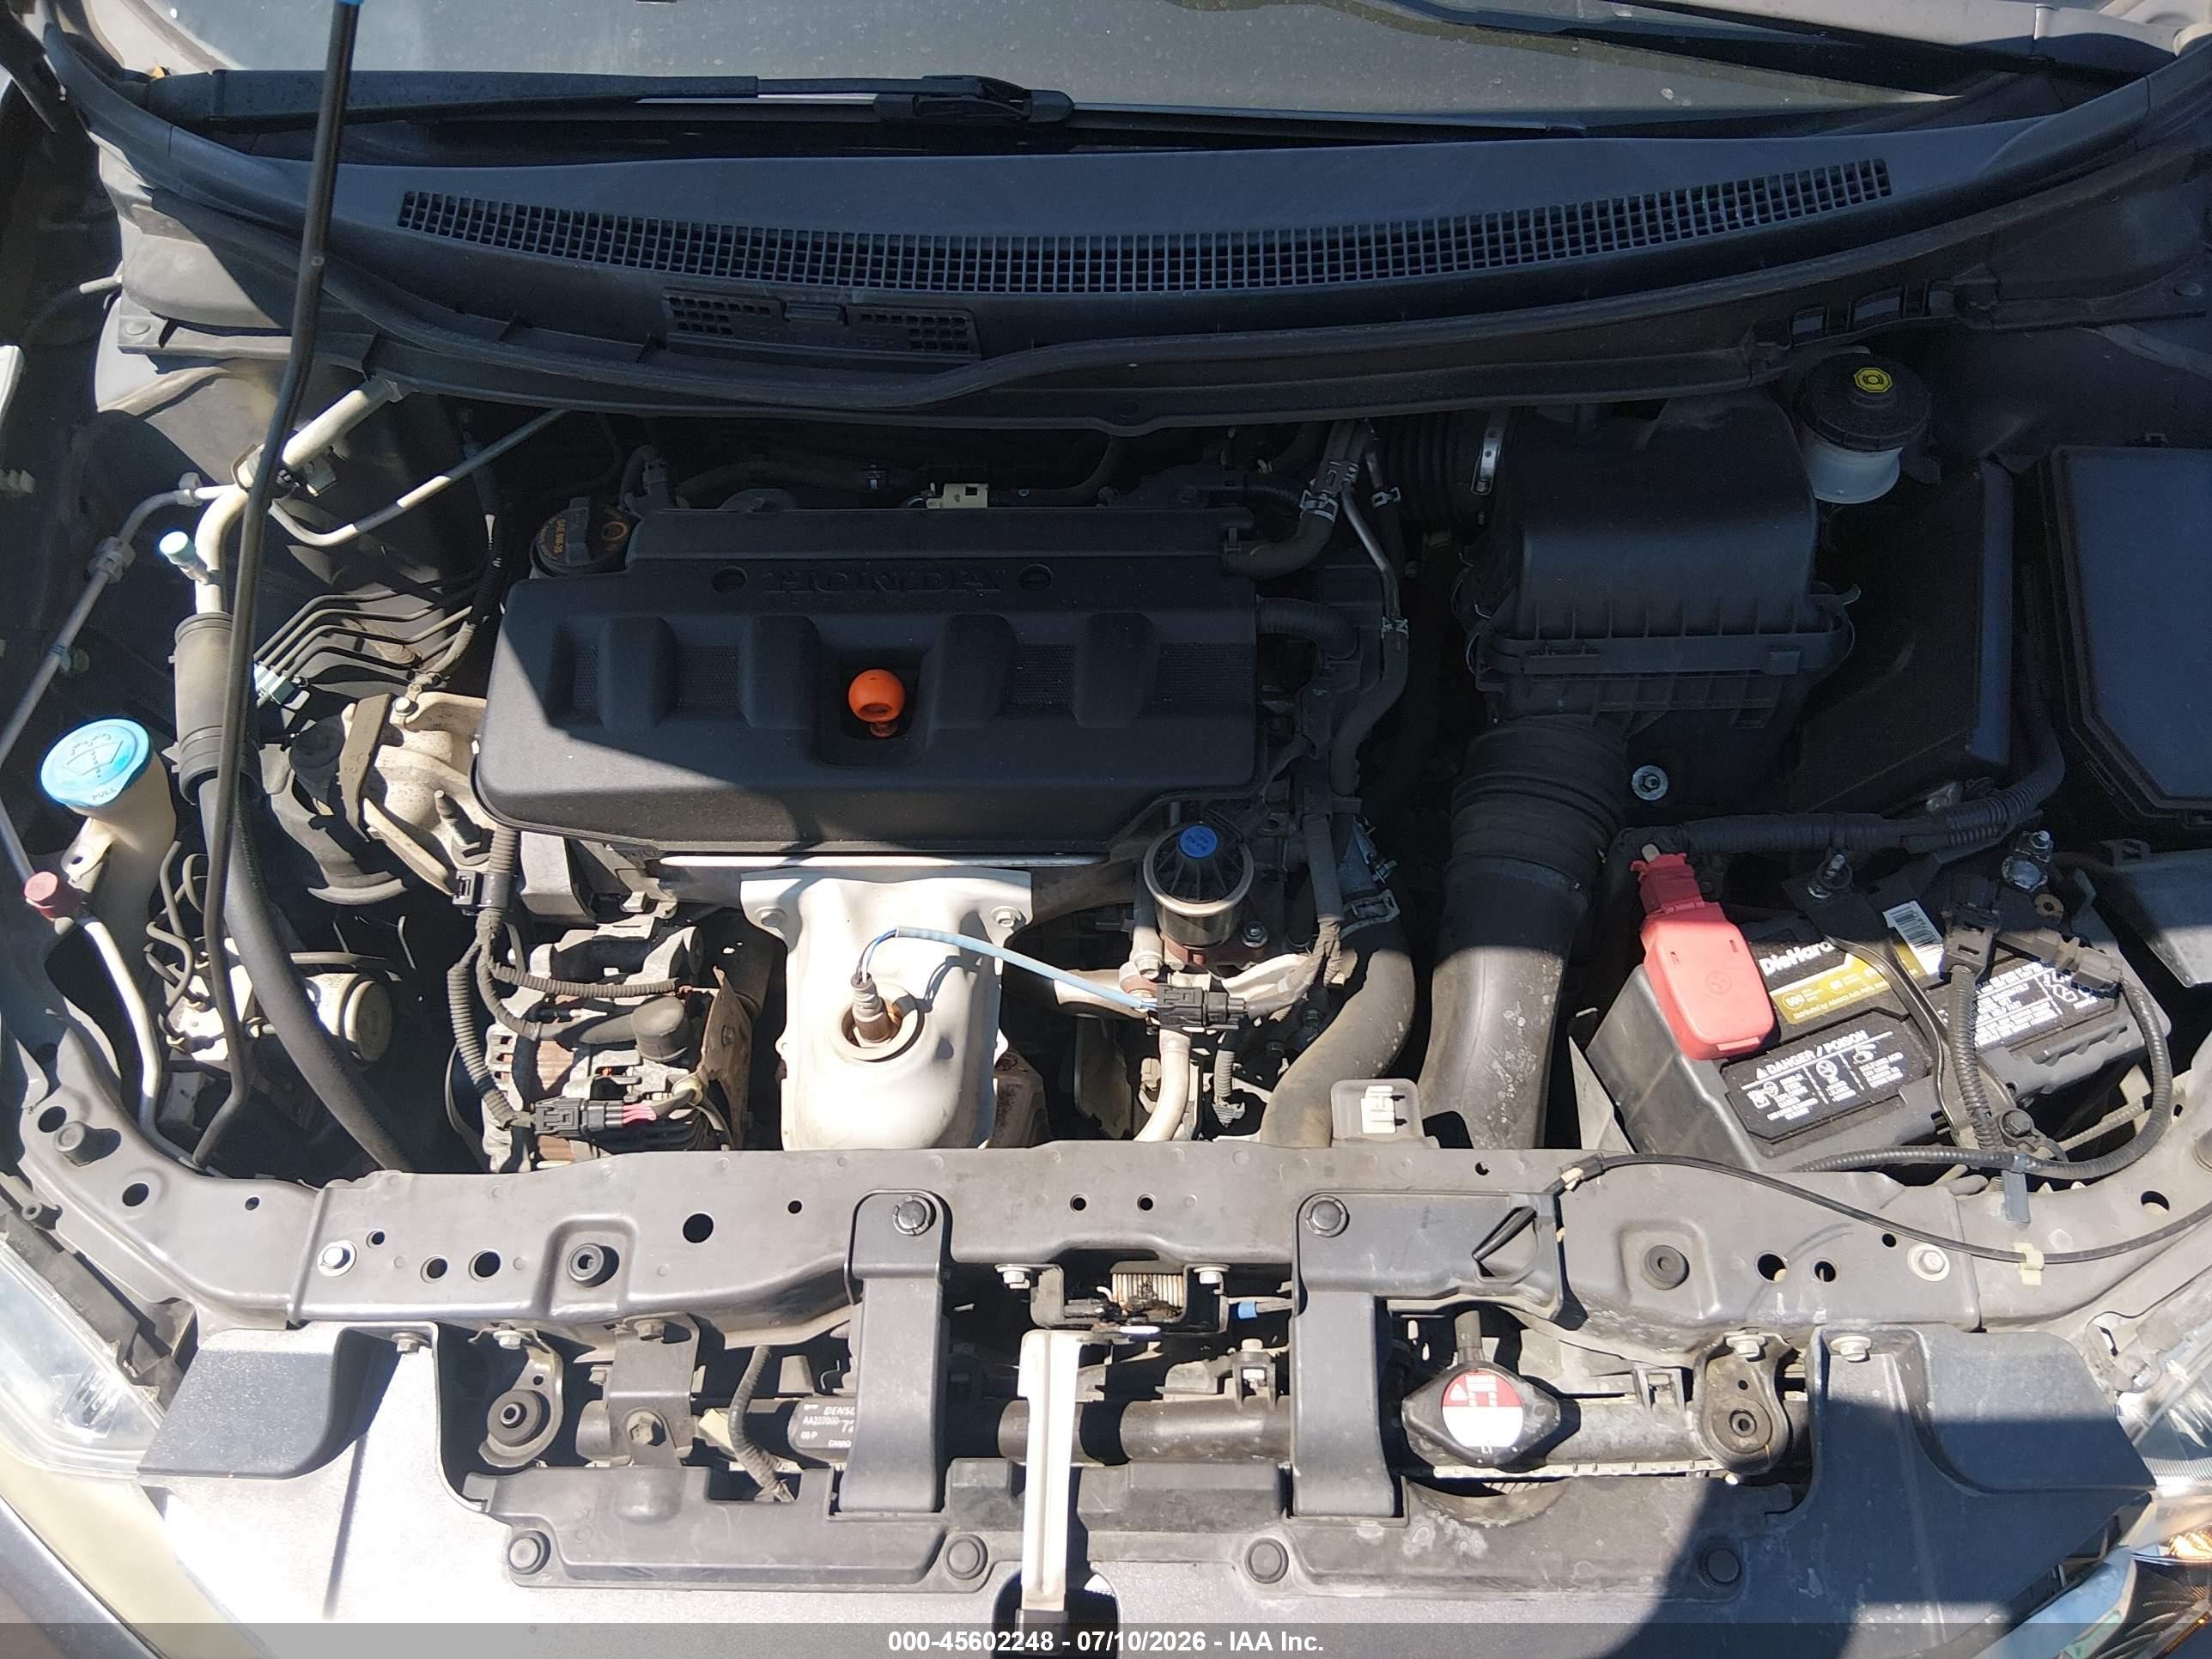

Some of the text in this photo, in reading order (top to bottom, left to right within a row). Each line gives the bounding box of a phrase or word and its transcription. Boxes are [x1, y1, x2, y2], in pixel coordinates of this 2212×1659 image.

[763, 570, 1002, 592] HONDA
[1765, 1050, 1815, 1073] DANGER
[1823, 1030, 1869, 1054] POISON
